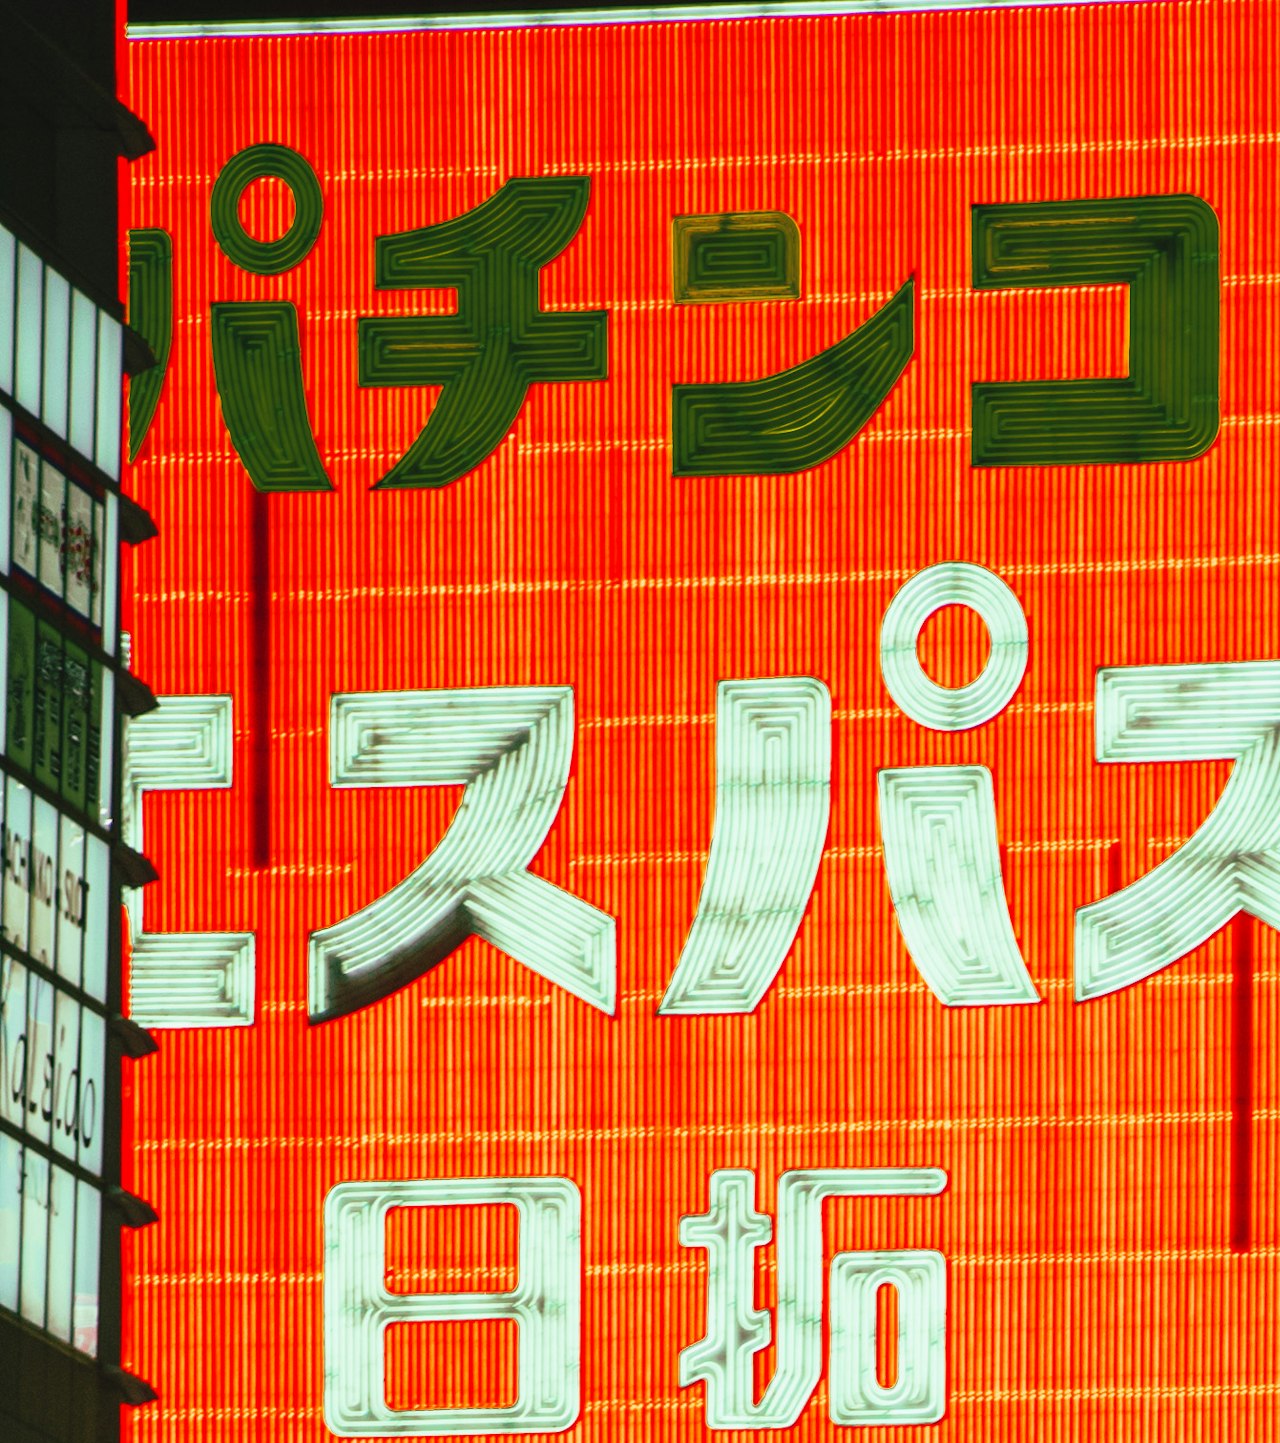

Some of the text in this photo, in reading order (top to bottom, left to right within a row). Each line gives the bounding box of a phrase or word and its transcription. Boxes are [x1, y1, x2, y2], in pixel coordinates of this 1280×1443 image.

[128, 143, 1222, 492] パチンコ
[323, 1168, 948, 1437] 日拓
